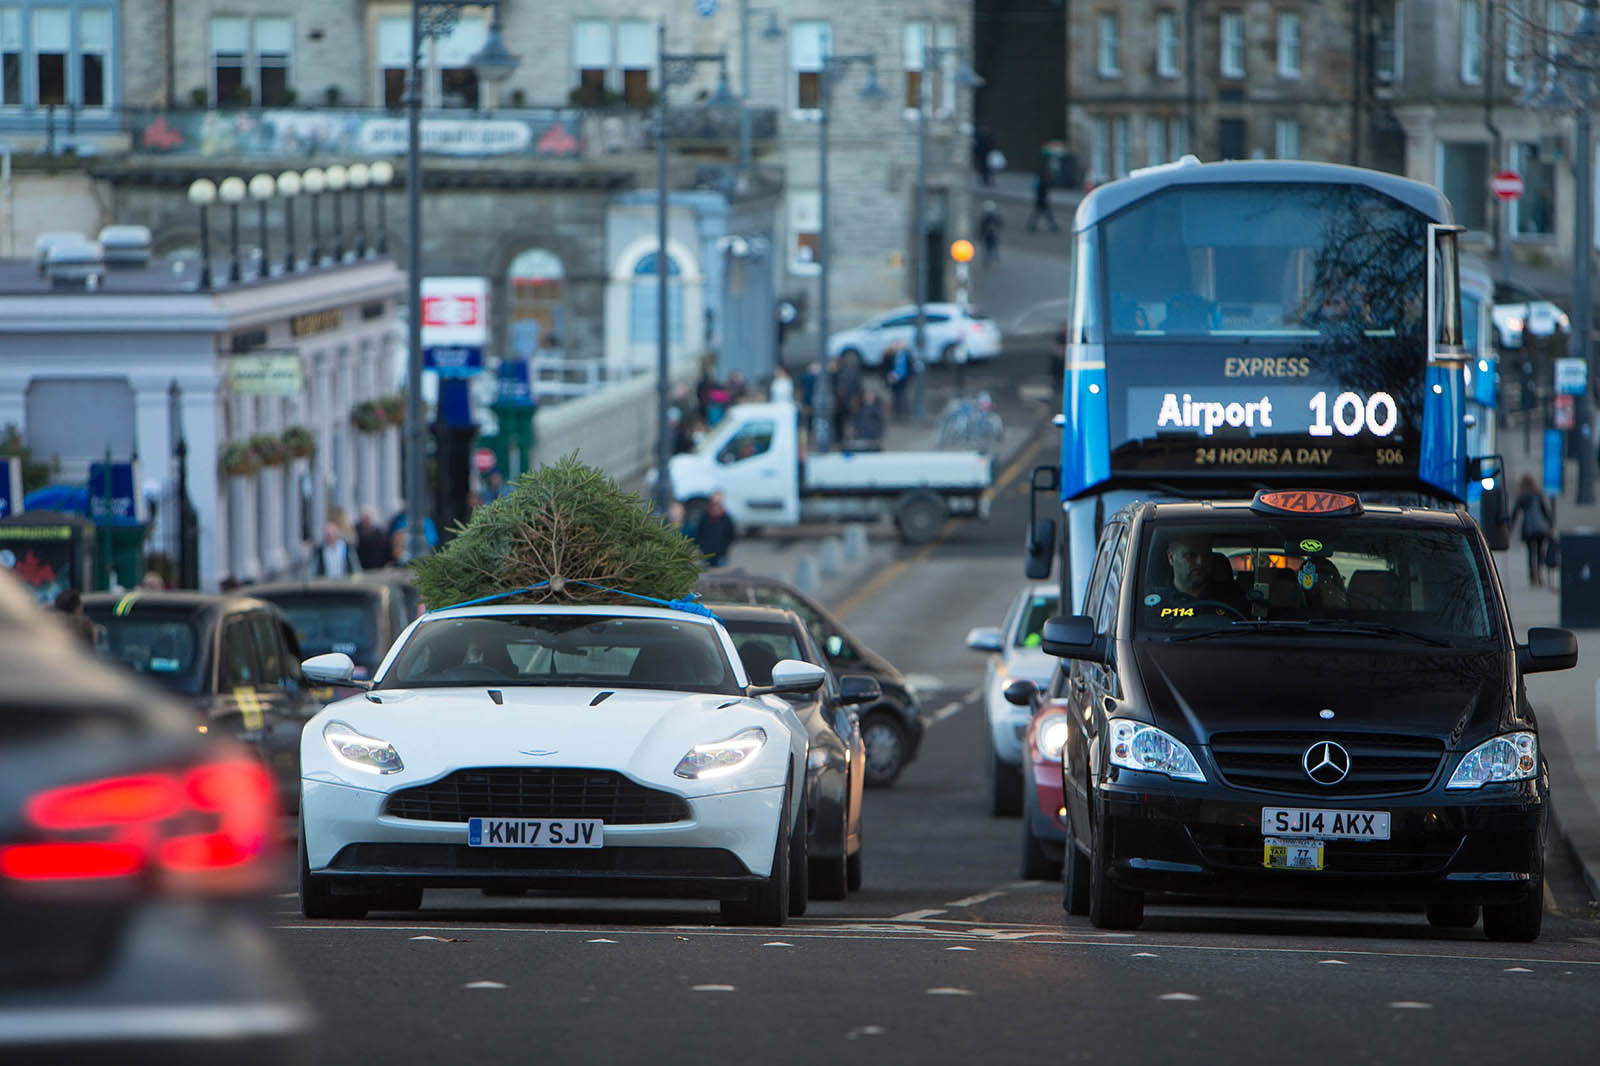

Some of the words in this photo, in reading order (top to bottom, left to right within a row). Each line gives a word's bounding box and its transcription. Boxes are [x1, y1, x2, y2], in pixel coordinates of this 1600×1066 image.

[1224, 358, 1310, 377] EXPRESS
[1157, 393, 1273, 435] Airport
[1308, 391, 1398, 437] 100
[1195, 448, 1216, 464] 24
[1218, 448, 1278, 465] HOURS
[1278, 449, 1293, 464] A
[1296, 448, 1333, 465] DAY
[1376, 449, 1404, 465] 506
[1280, 493, 1336, 511] TAXI
[1160, 608, 1195, 617] P114
[1276, 811, 1325, 833] SJ14
[1332, 813, 1375, 835] AKX
[489, 821, 542, 844] KW17
[549, 822, 595, 844] SJV
[1297, 849, 1310, 857] 77
